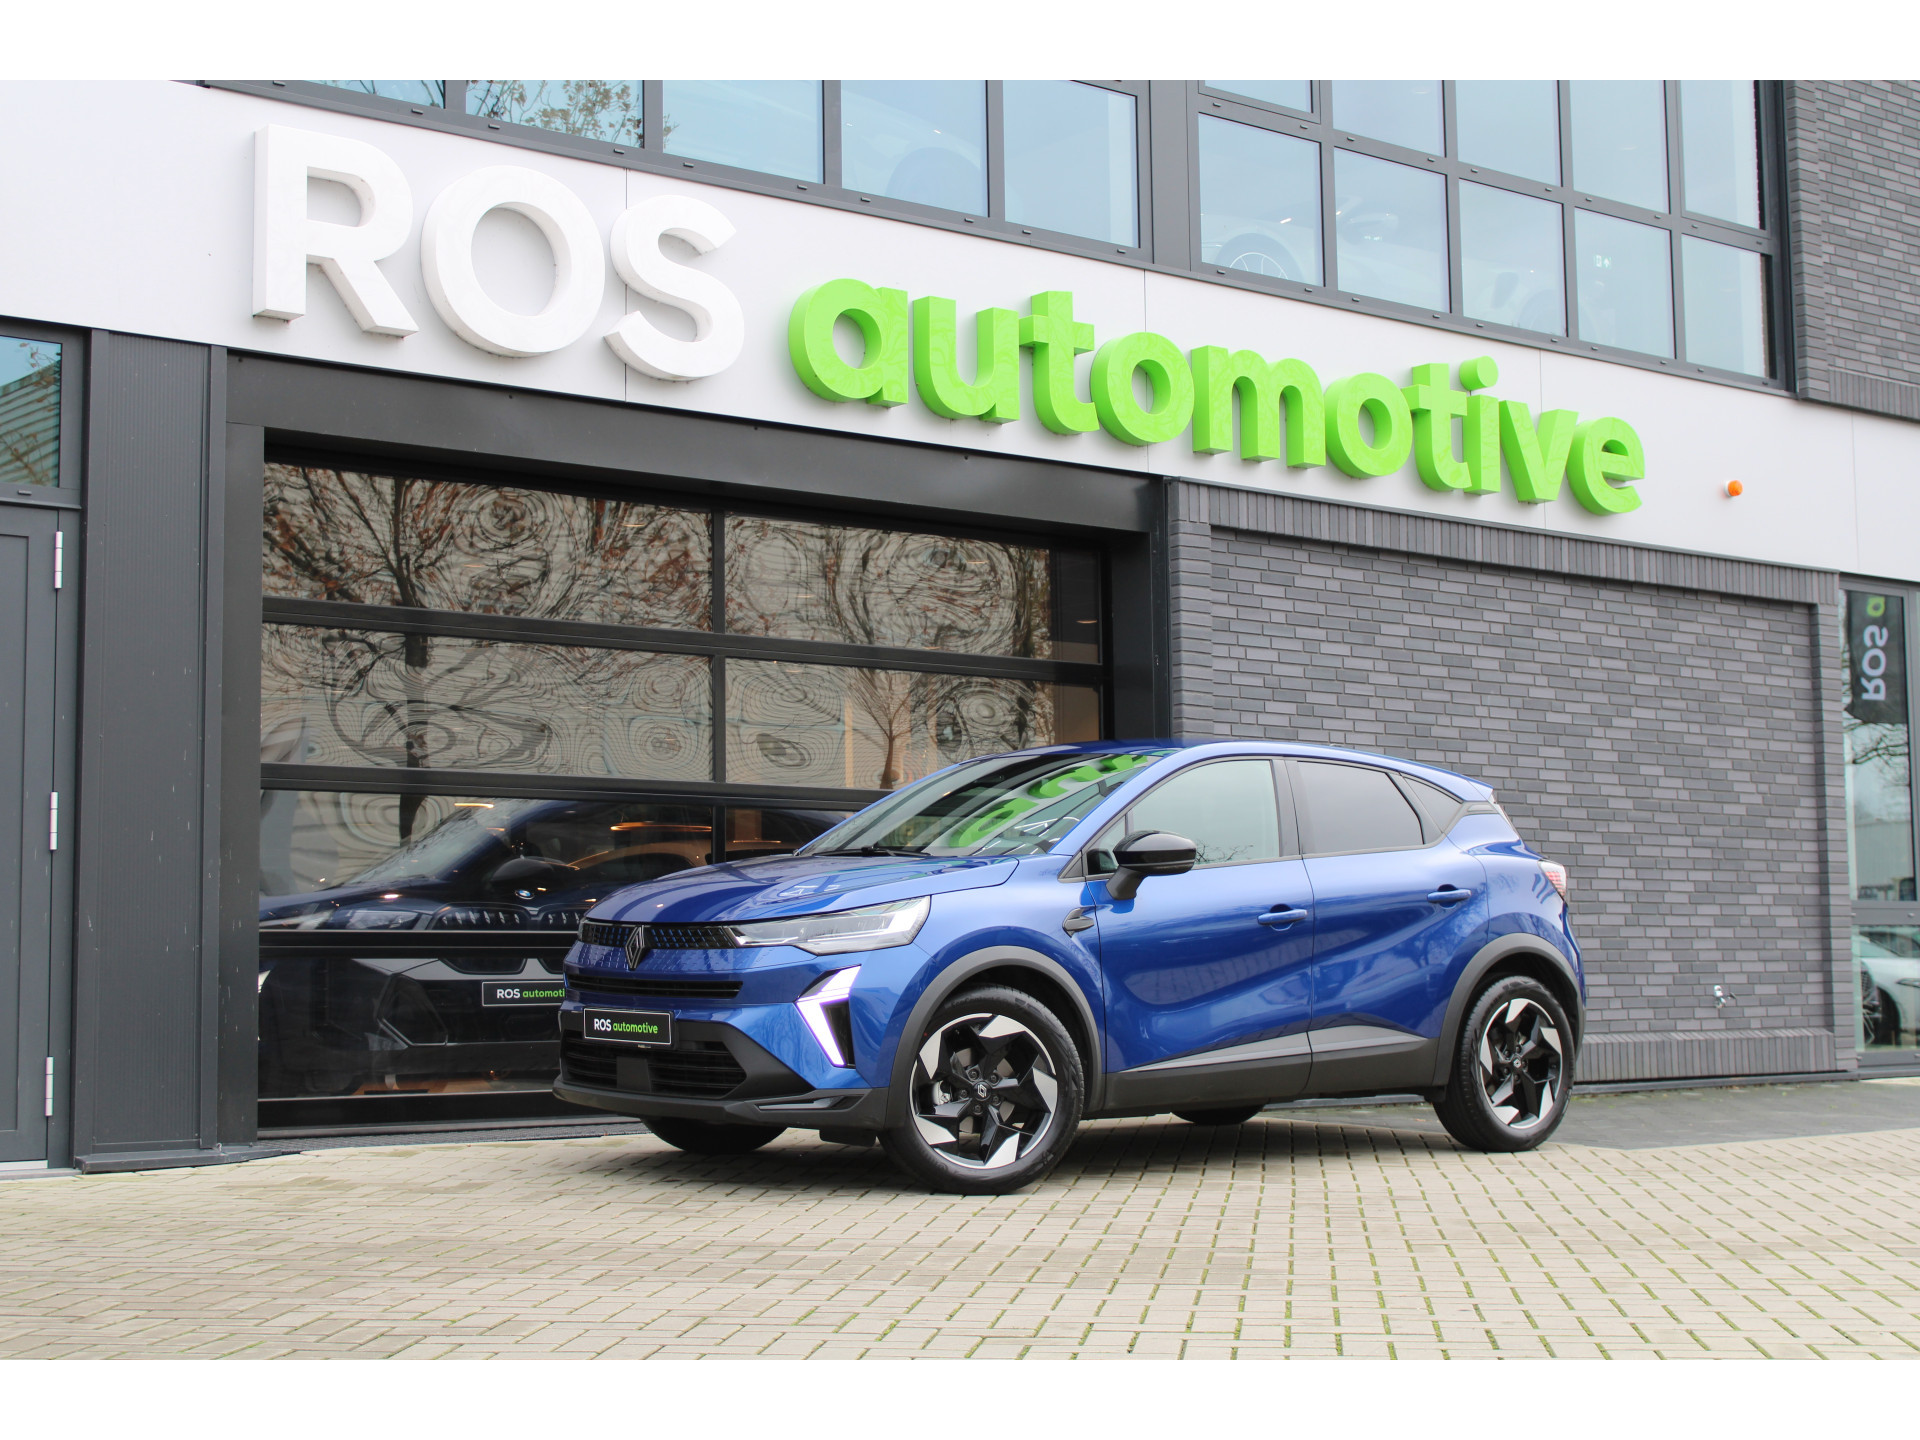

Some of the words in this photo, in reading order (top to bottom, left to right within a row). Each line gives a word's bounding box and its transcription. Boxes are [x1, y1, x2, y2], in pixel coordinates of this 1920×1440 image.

[252, 124, 745, 381] ROS
[788, 278, 1645, 516] automotive
[496, 988, 521, 999] ROS
[522, 988, 566, 998] automoti
[593, 1018, 612, 1032] ROS
[612, 1022, 659, 1034] automotive
